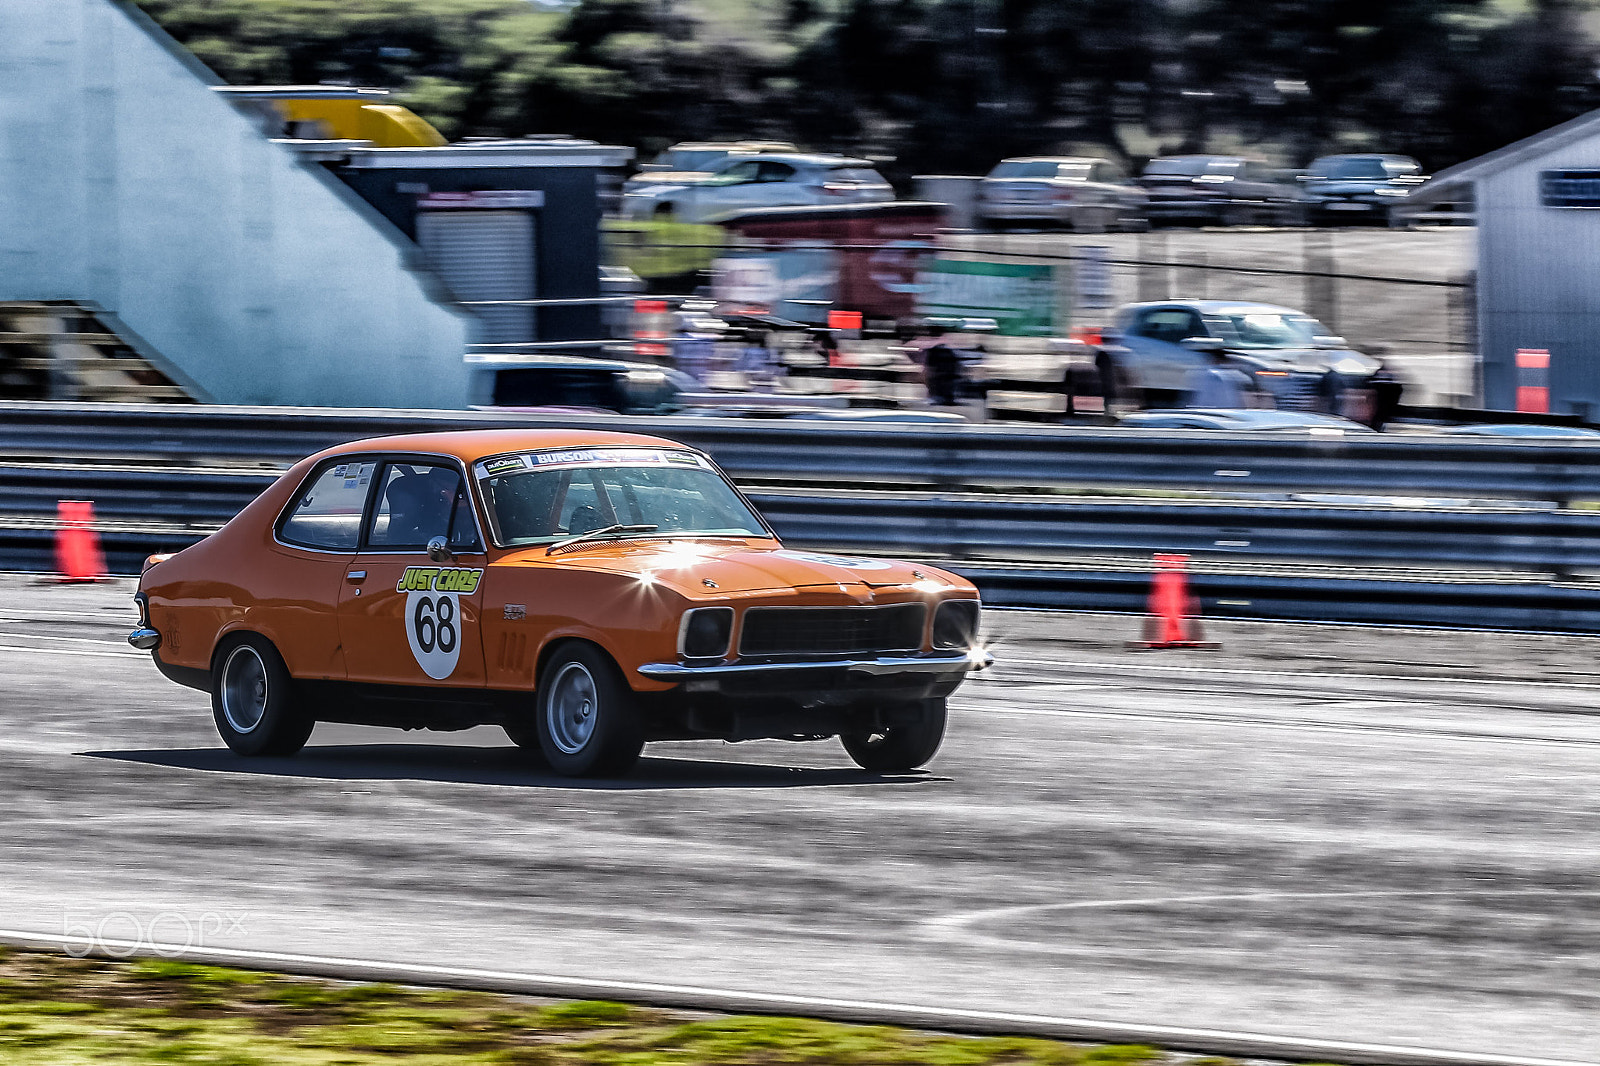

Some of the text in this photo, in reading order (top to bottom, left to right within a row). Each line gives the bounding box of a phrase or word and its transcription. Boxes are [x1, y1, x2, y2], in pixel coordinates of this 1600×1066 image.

[537, 451, 594, 464] BURSON
[398, 568, 482, 592] JUST CARS
[415, 596, 456, 654] 68
